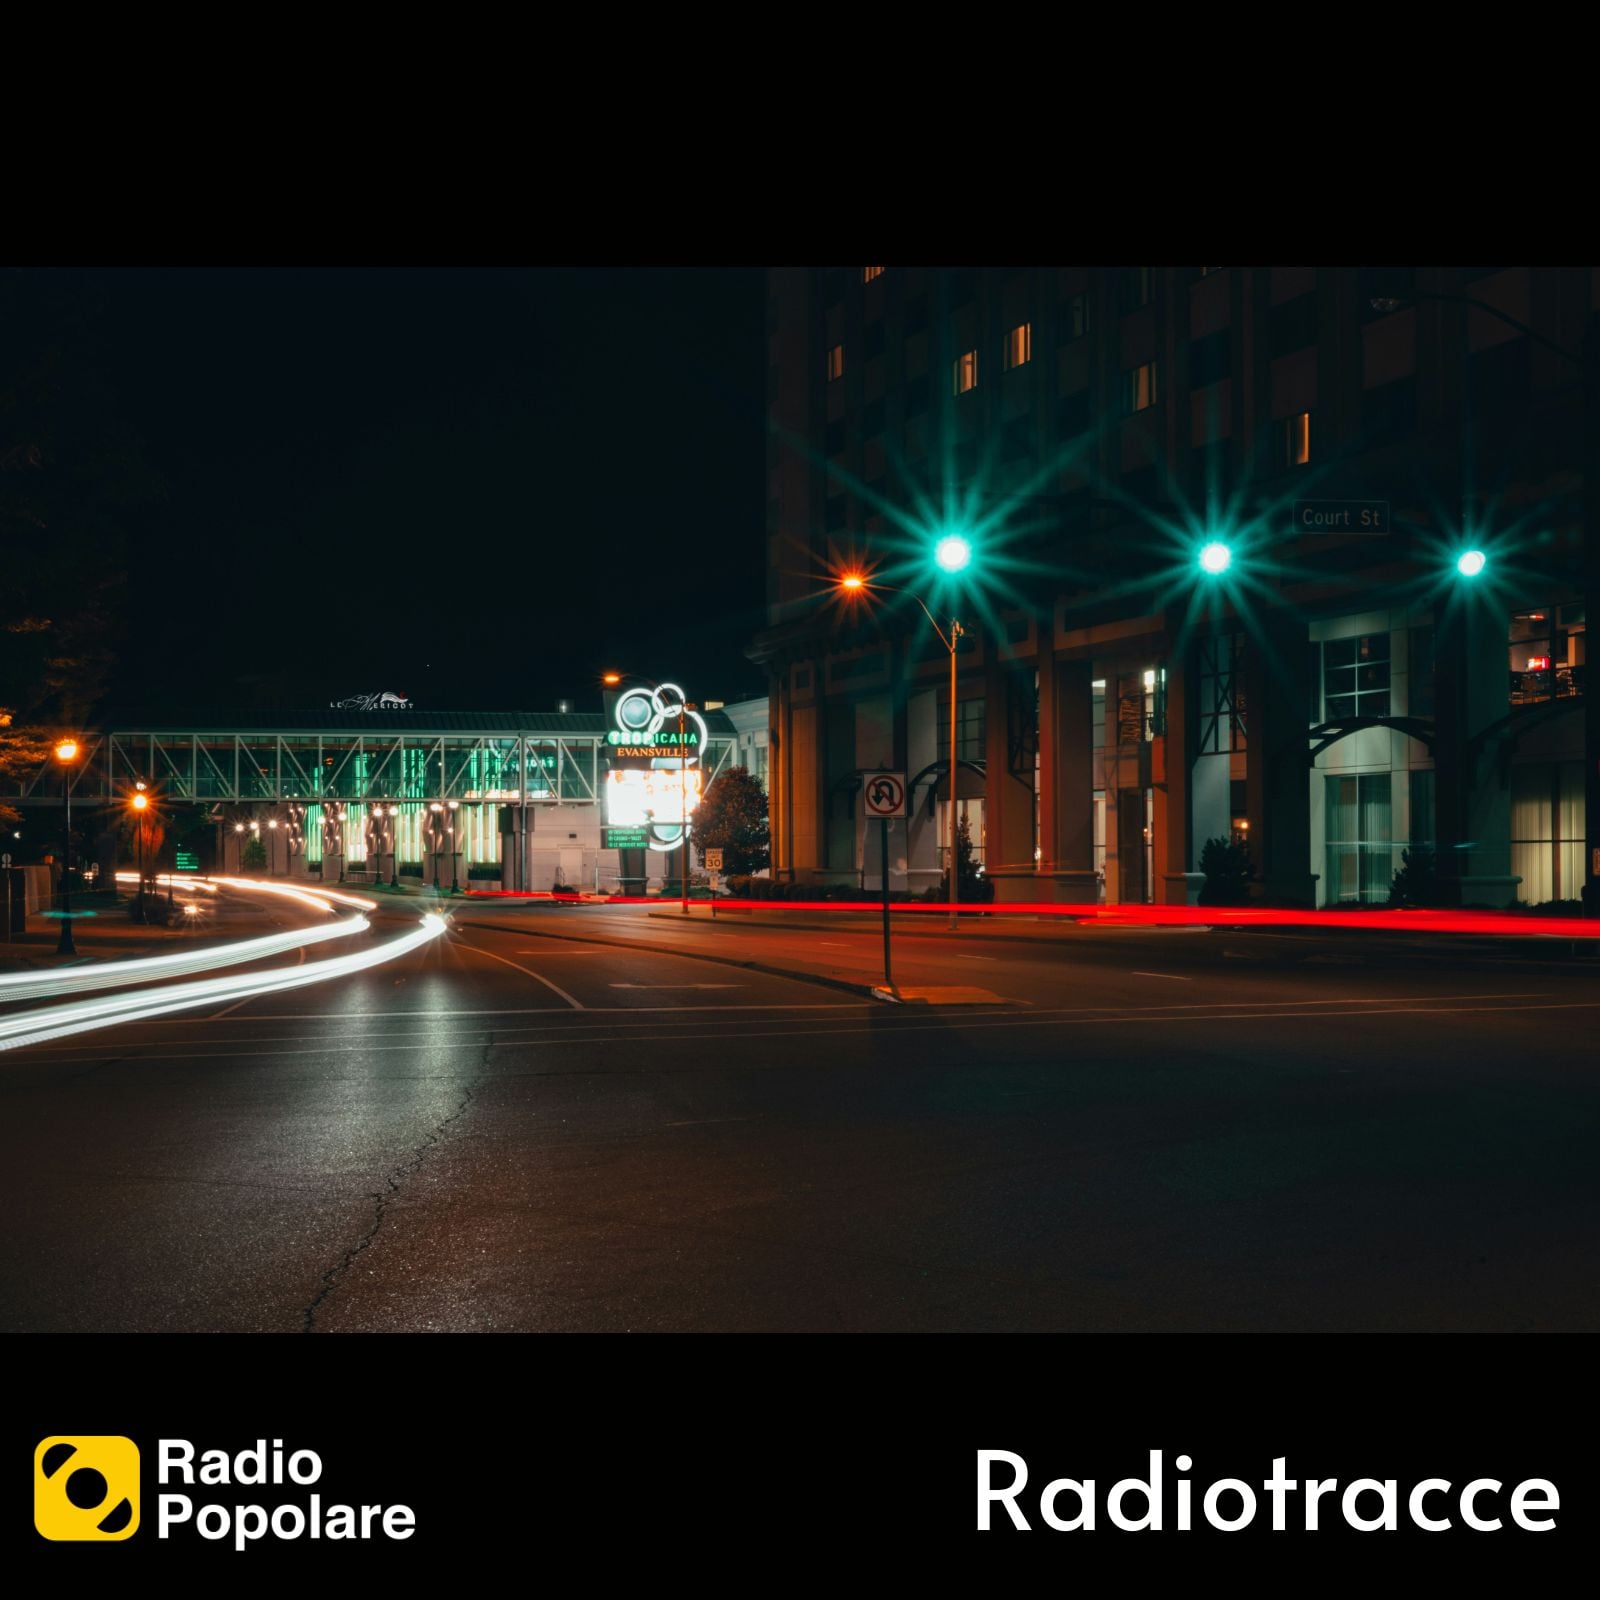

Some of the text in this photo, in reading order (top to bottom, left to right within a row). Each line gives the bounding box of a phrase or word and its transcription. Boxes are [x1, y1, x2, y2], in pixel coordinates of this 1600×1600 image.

[1302, 508, 1380, 526] Court St
[617, 747, 689, 757] EVANSVILLE
[707, 859, 721, 867] 30
